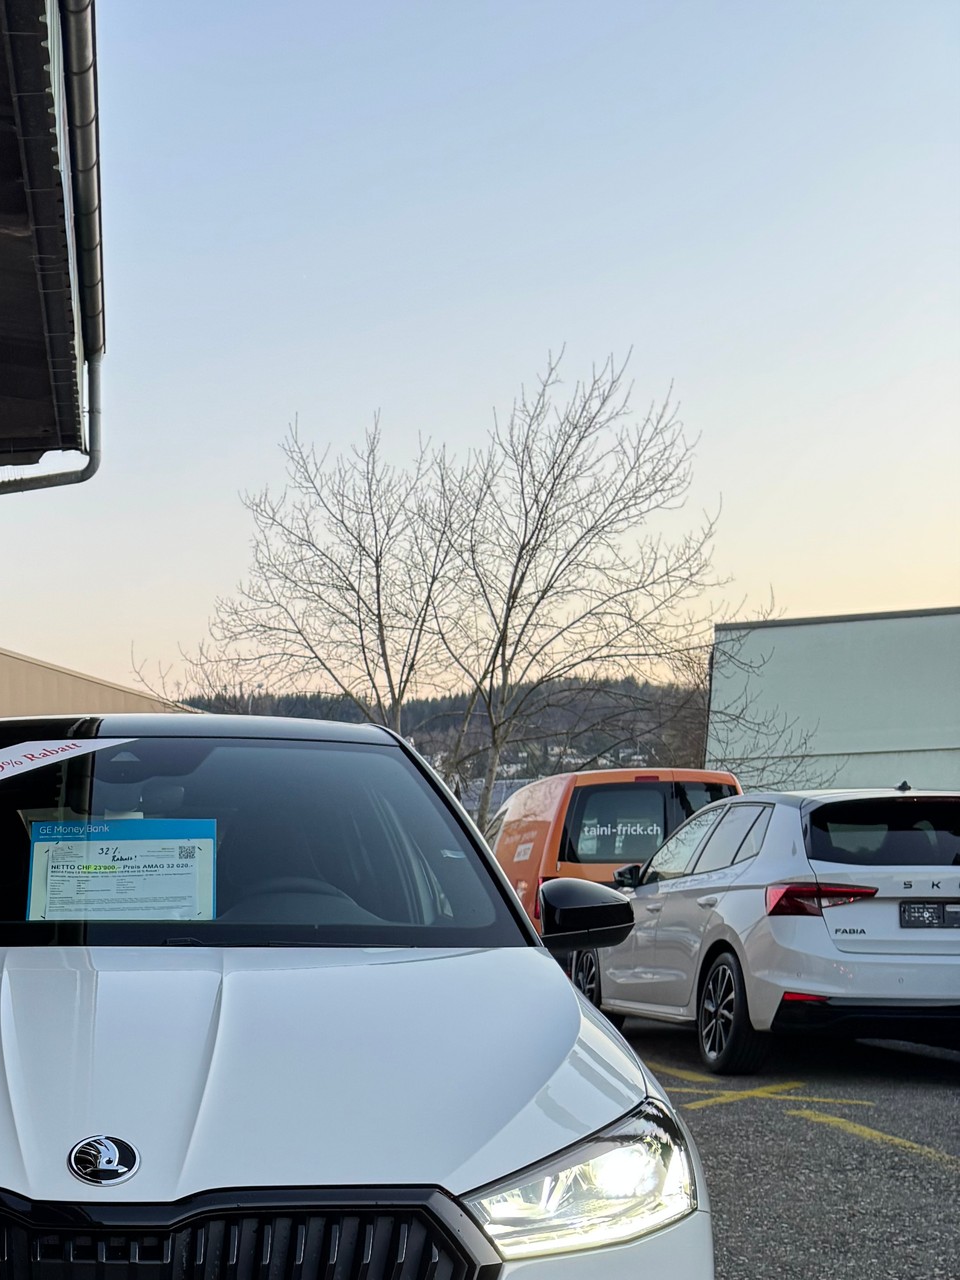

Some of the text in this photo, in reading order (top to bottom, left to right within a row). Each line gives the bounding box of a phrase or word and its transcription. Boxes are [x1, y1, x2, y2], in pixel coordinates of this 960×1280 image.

[23, 742, 82, 762] Rabatt
[39, 823, 110, 834] GE Money Bank
[583, 823, 662, 836] taini-frick.ch
